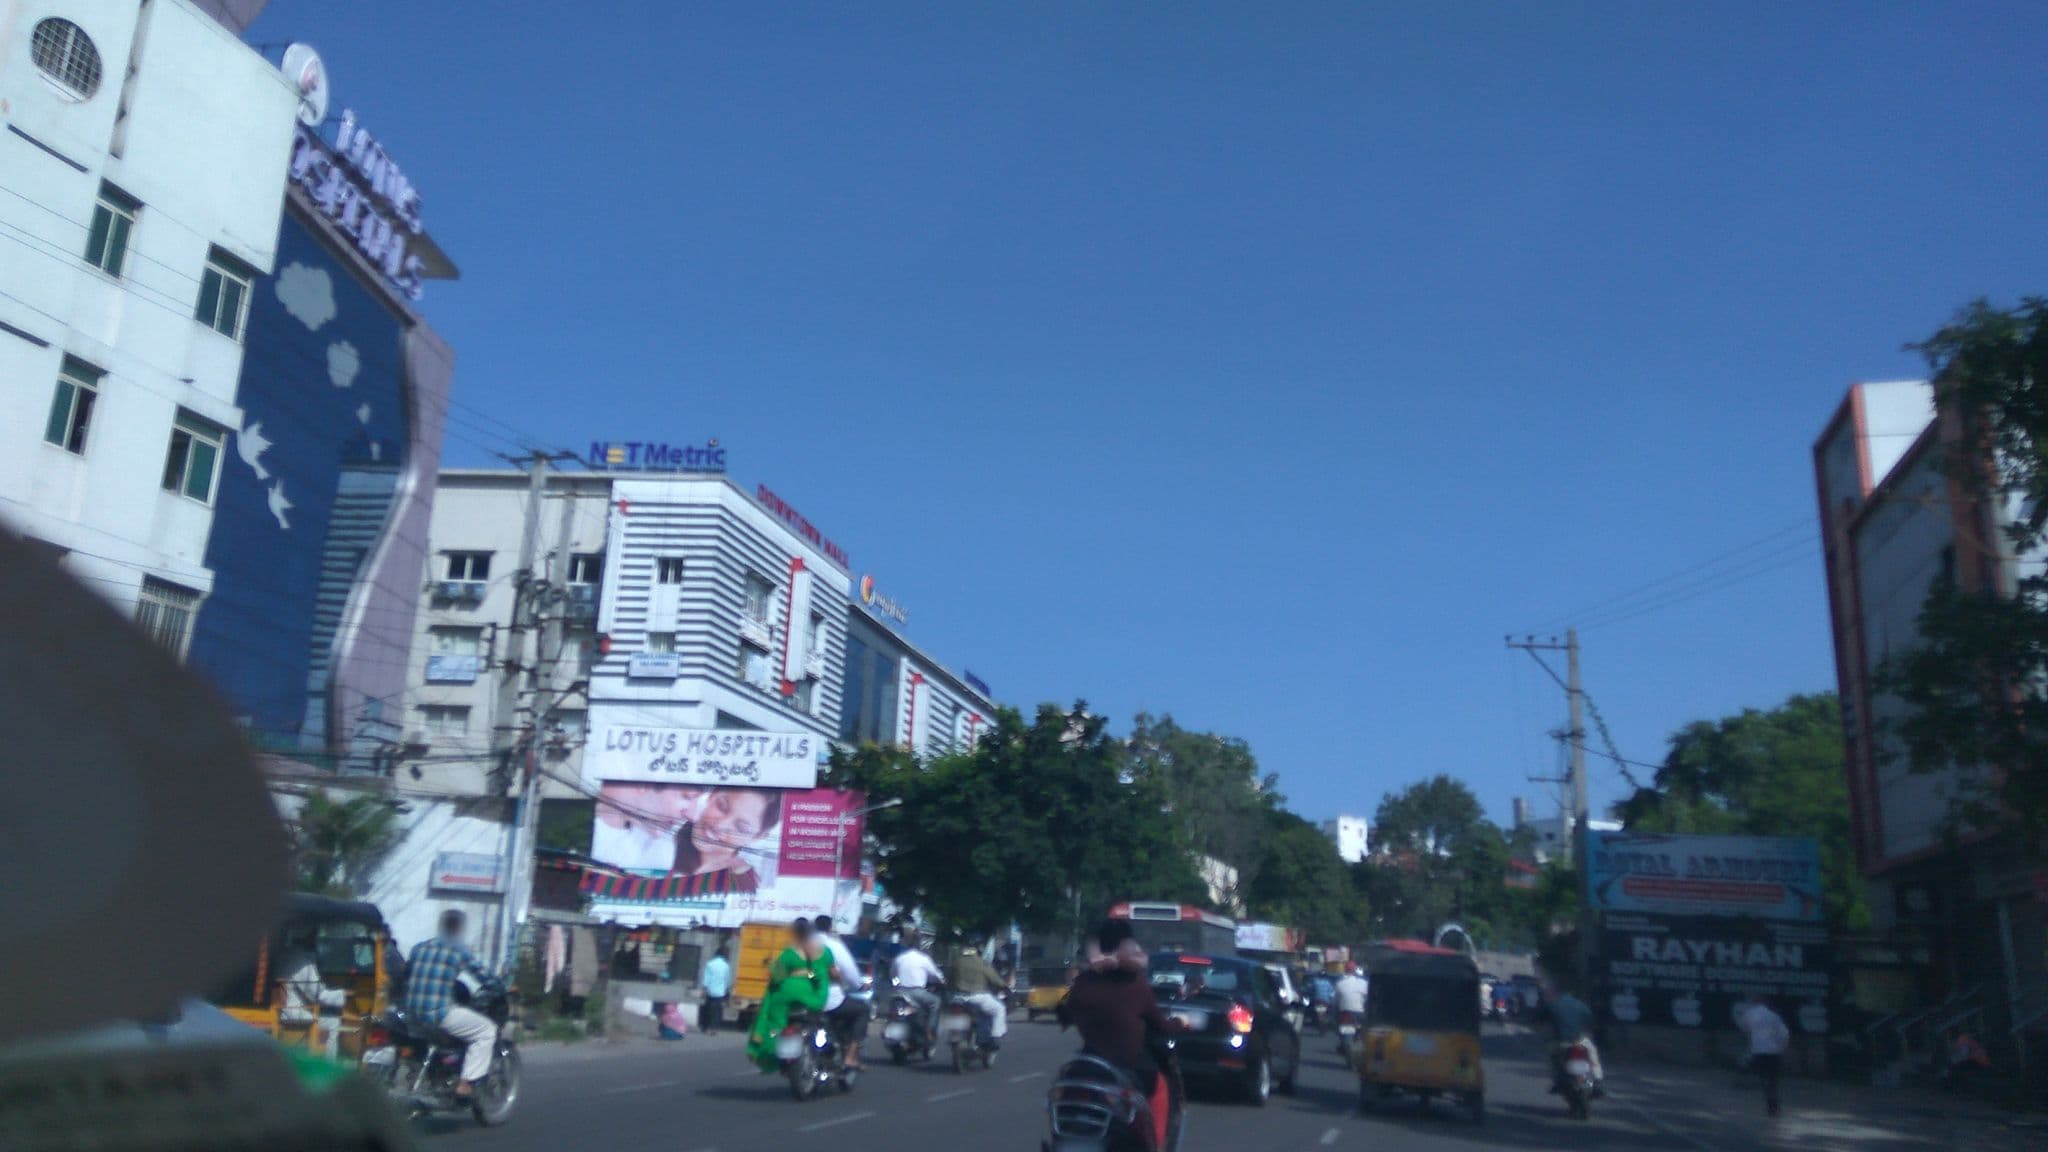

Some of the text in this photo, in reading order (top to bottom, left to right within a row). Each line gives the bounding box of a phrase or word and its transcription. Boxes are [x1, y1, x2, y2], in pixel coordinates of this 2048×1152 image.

[606, 730, 810, 758] LOTUS HOSPITALS
[731, 897, 776, 911] LOTUS
[1632, 937, 1803, 967] RAYHAN
